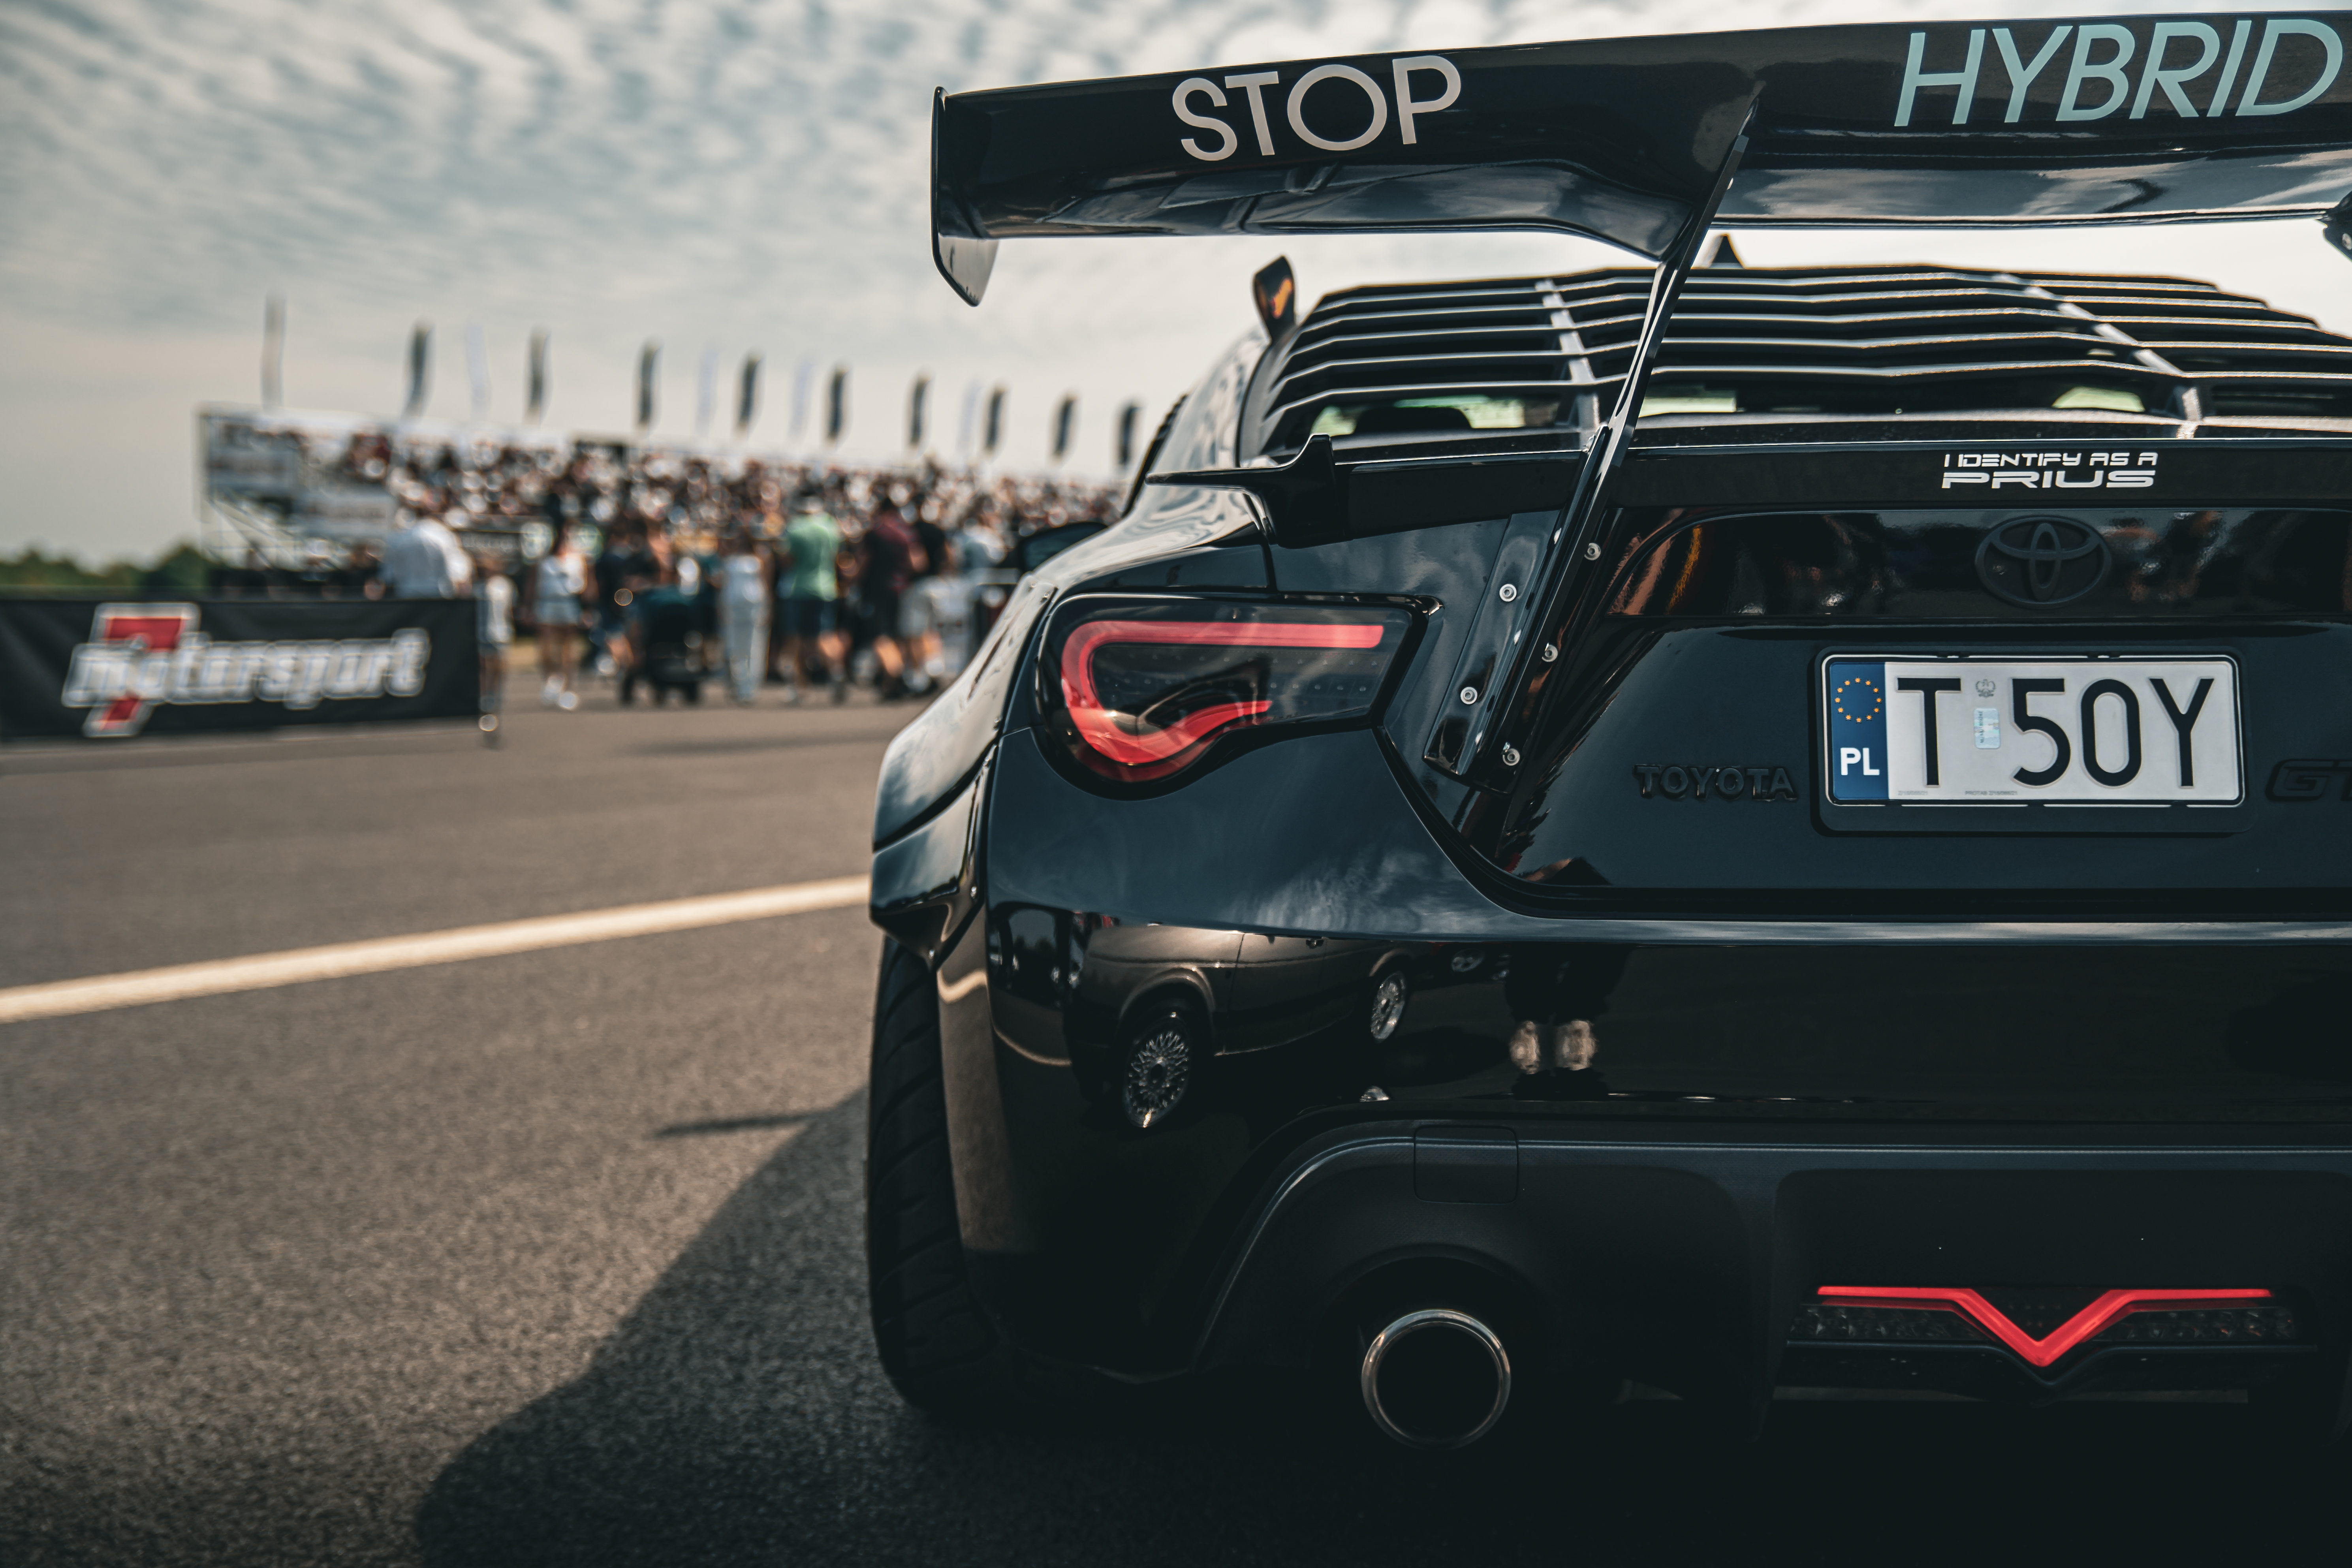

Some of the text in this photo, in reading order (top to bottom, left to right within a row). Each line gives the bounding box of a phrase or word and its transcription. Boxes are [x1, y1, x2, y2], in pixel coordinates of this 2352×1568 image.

[1894, 19, 2343, 127] HYBRID
[1172, 55, 1461, 161] STOP
[1944, 452, 2158, 467] I IDENTIFY AS A
[1941, 470, 2156, 489] PRIUS
[1897, 677, 2215, 787] T 50Y
[1840, 747, 1880, 776] PL
[1634, 765, 1798, 800] TOYOTA
